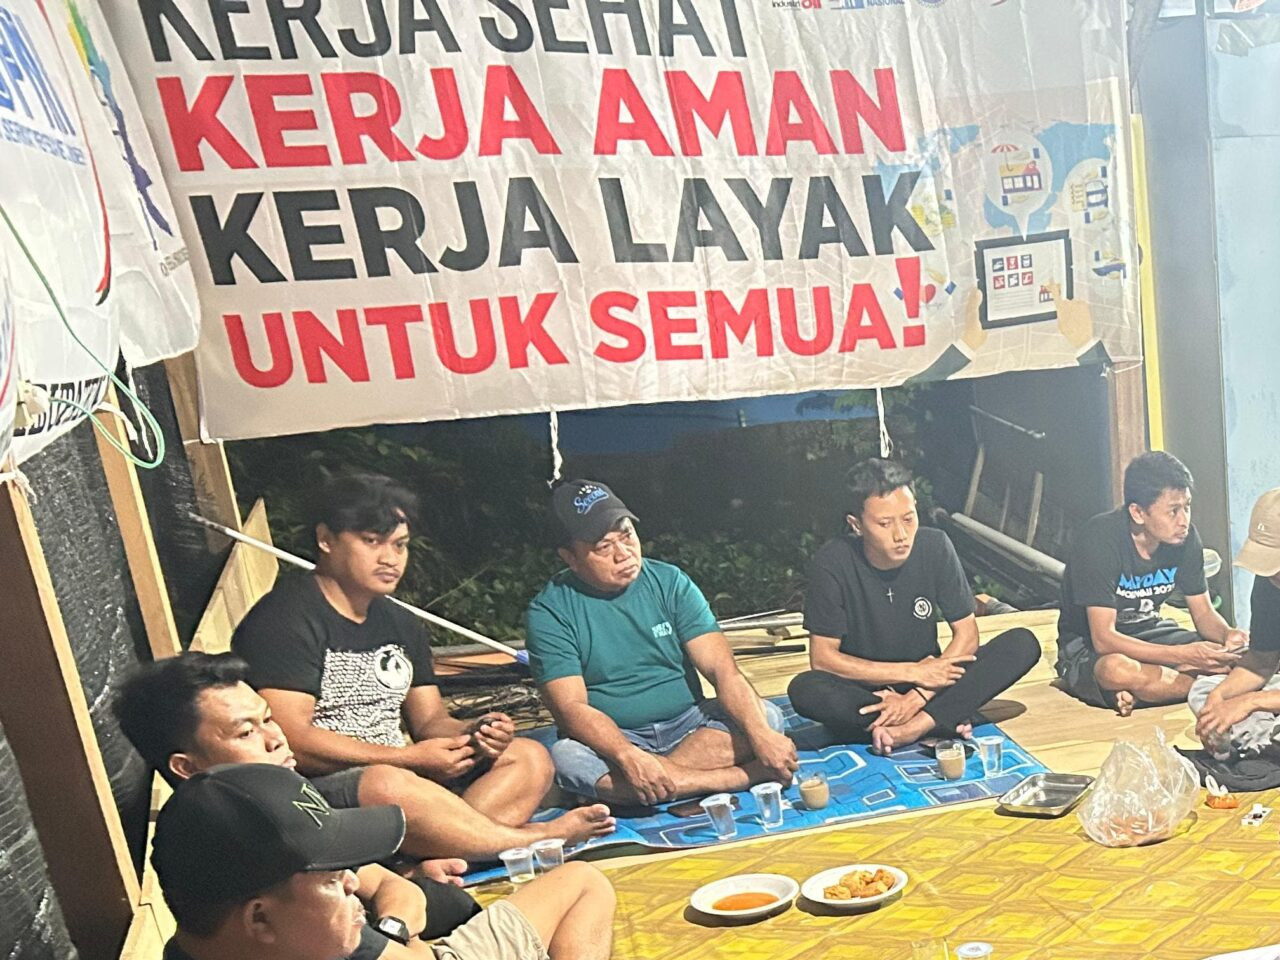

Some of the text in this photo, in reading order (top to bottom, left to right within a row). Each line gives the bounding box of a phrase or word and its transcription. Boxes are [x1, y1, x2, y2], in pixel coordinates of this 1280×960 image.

[138, 0, 461, 61] KERJA
[157, 65, 562, 172] KERJA
[593, 67, 907, 157] AMAN
[188, 171, 935, 286] KERJA LAYAK
[222, 257, 926, 388] UNTUK SEMUA!
